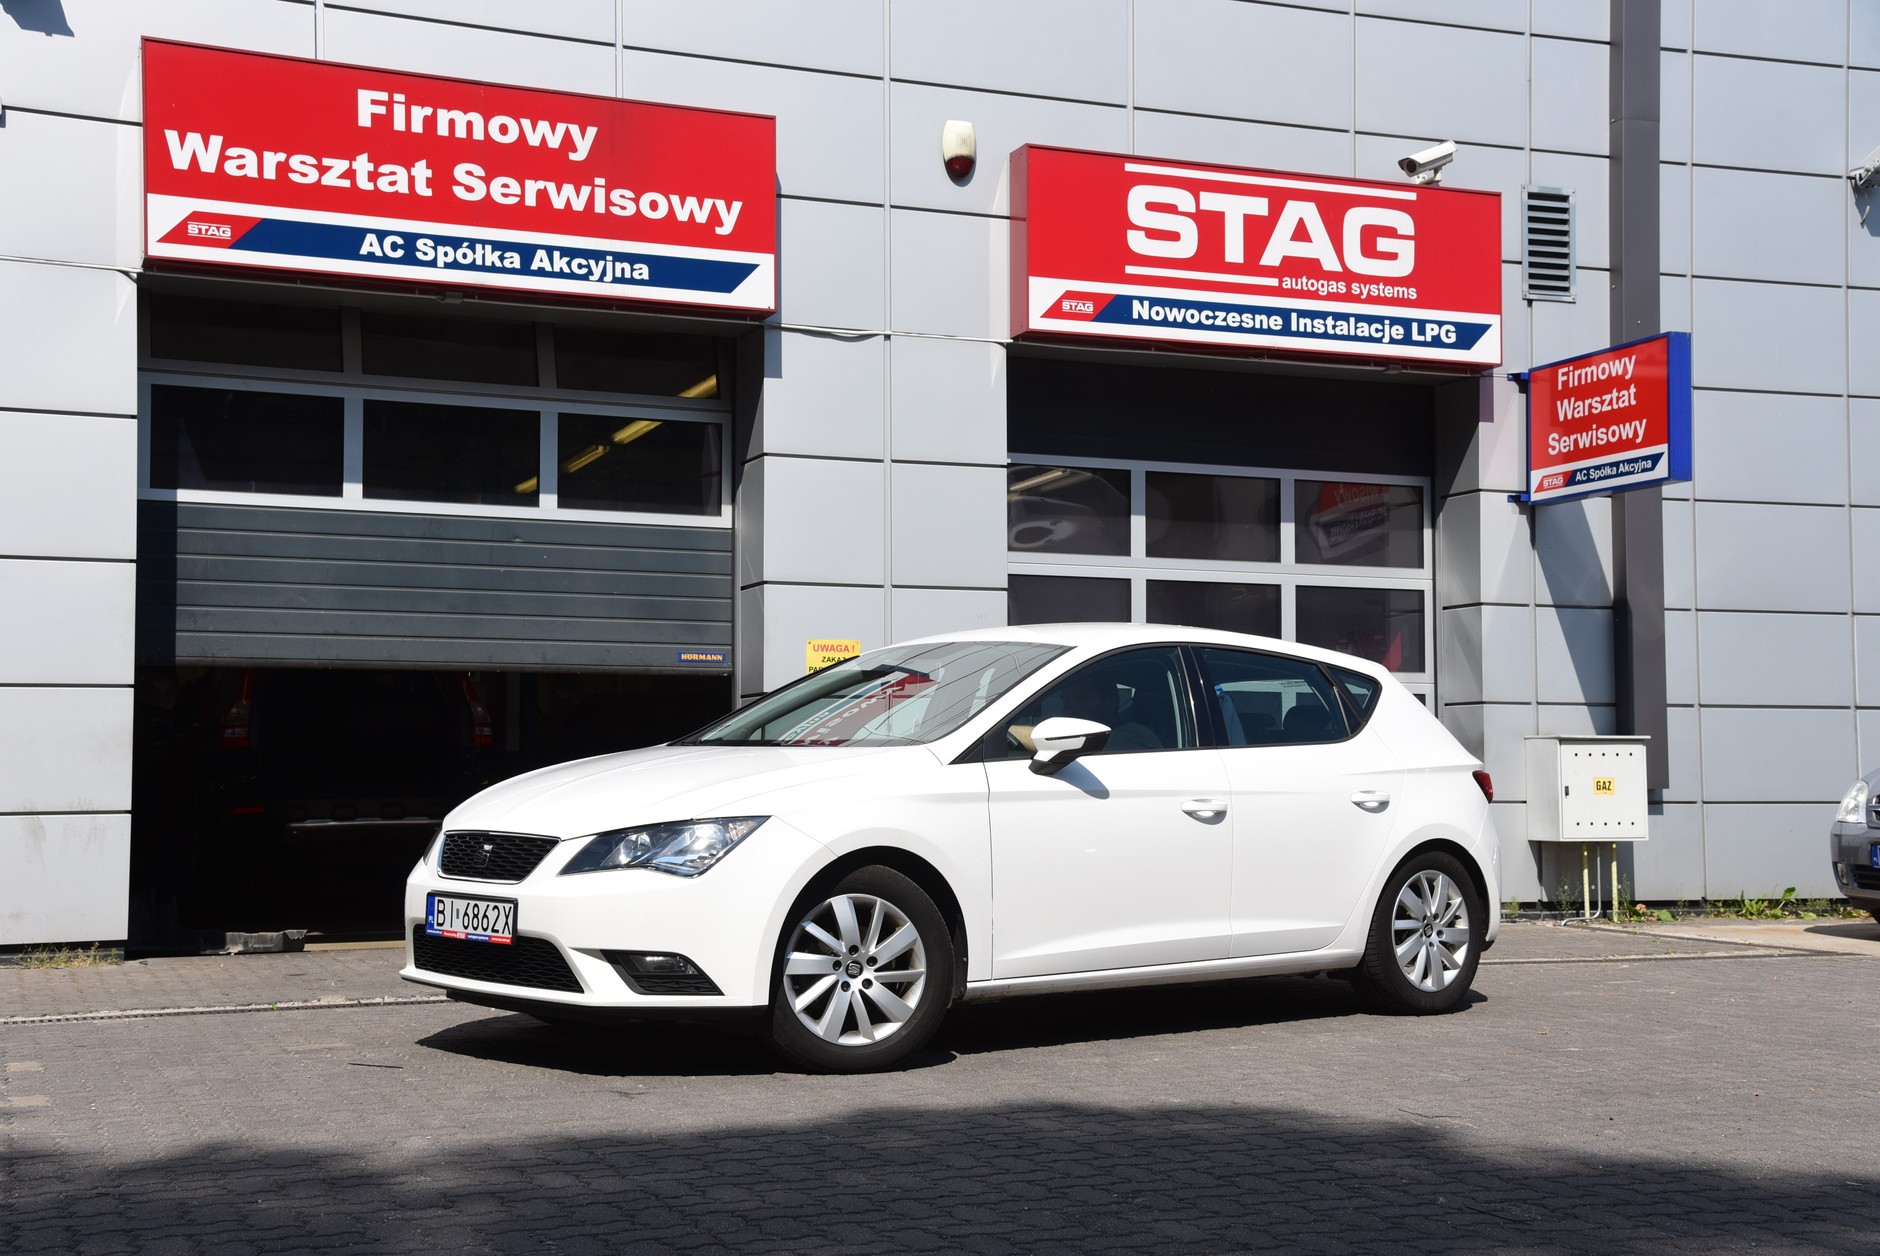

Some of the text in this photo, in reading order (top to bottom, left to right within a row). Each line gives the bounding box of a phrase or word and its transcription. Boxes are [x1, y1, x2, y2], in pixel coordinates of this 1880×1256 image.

[357, 88, 598, 162] Firmowy
[164, 129, 743, 236] Warsztat Serwisowy
[187, 224, 232, 237] STAG
[1126, 184, 1415, 278] STAG
[359, 233, 650, 282] AC Spółka Akcyjna
[1282, 275, 1418, 300] autogas systems
[1062, 301, 1094, 312] STAG
[1132, 299, 1457, 344] Nowoczesne Instalacje LPG
[1558, 355, 1636, 390] Firmowy
[1557, 384, 1636, 421] Warsztat
[1549, 419, 1647, 455] Serwisowy
[1543, 477, 1563, 488] STAG
[1575, 459, 1652, 482] AC Spółka Akcyjna
[812, 643, 850, 653] UWAGA
[1596, 780, 1612, 791] GAZ
[429, 915, 434, 923] PL
[462, 902, 512, 935] 6862X
